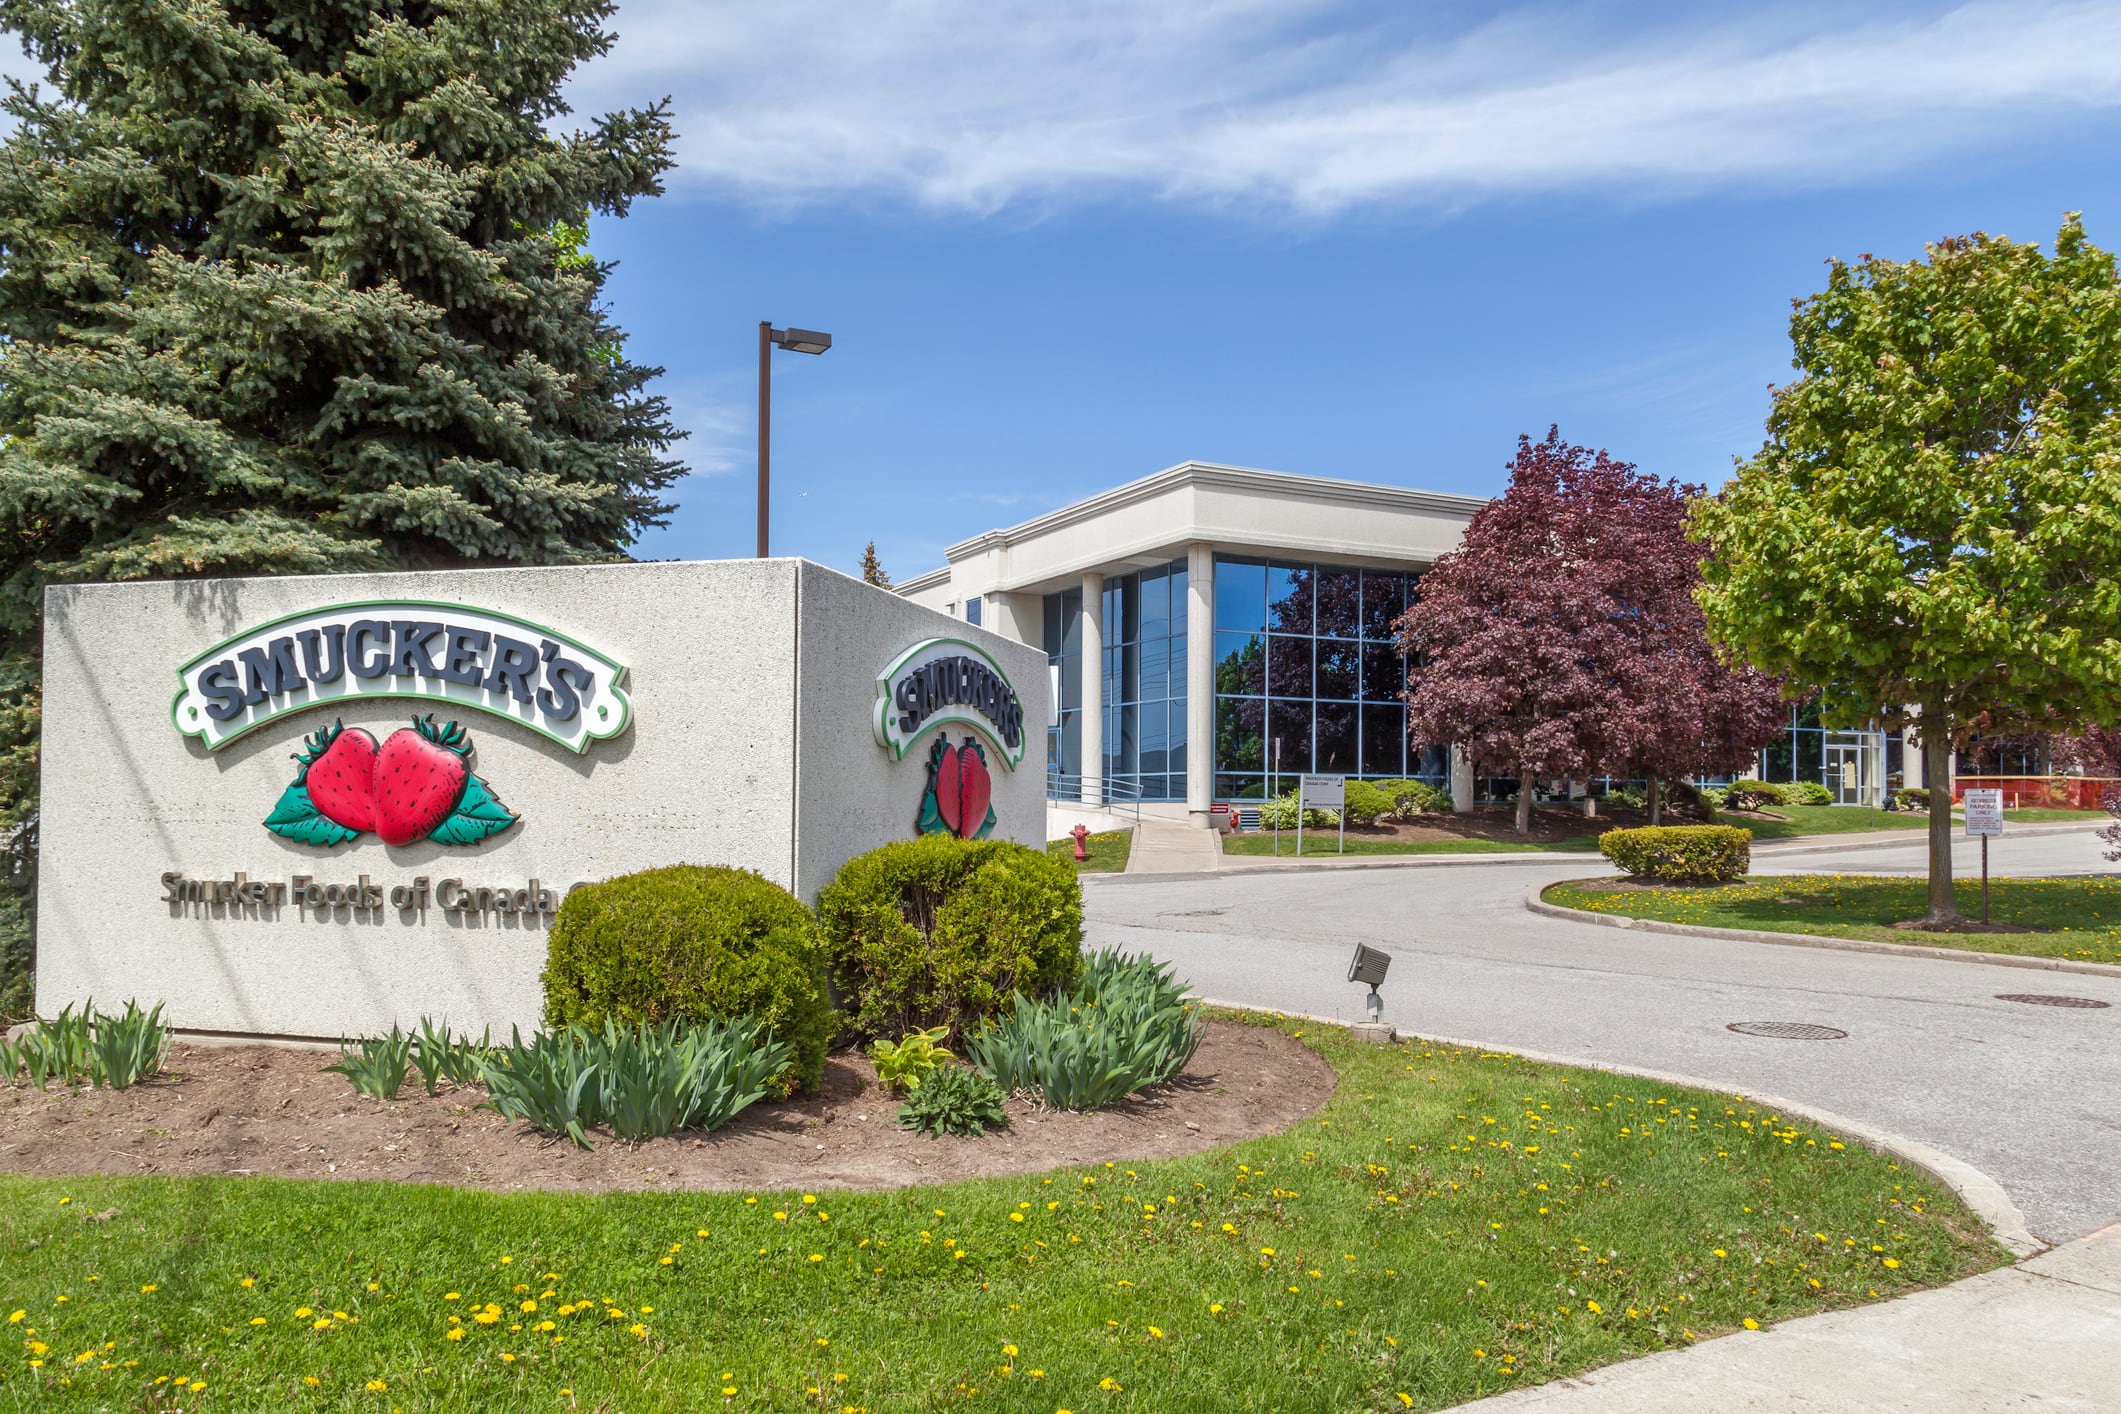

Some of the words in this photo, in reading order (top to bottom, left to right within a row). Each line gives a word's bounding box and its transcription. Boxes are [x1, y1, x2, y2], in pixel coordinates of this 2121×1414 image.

[197, 619, 594, 722] SMUCKER'S
[160, 871, 287, 905] Smucker
[292, 875, 382, 909] Foods
[390, 876, 430, 910] of
[436, 877, 558, 913] Canada
